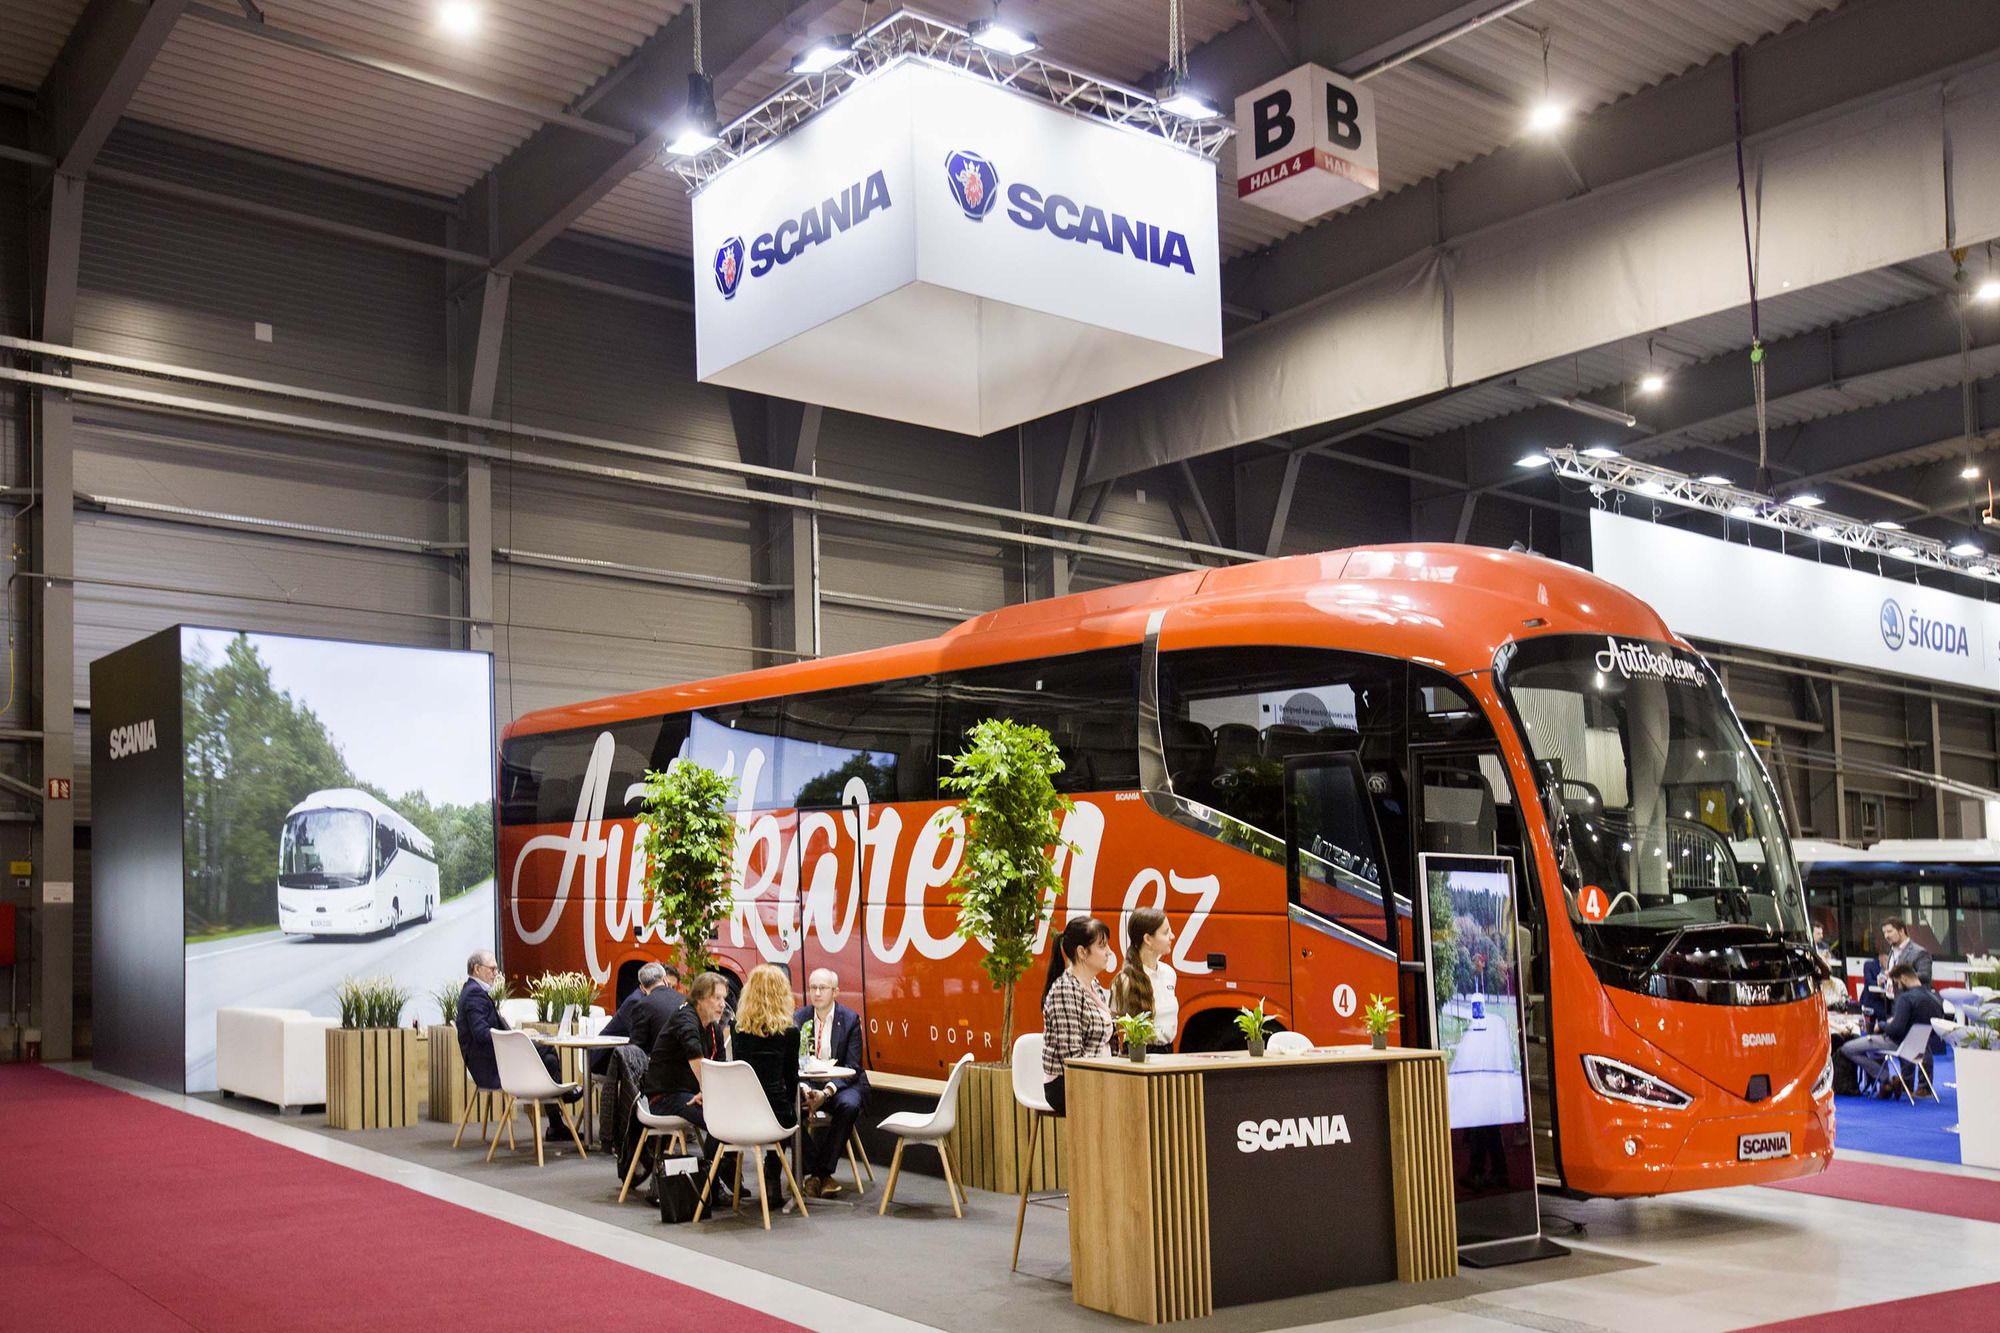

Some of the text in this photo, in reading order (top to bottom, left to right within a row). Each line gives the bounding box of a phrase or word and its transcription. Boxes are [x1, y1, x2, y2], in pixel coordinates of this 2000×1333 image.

[1253, 89, 1295, 160] B
[1327, 82, 1361, 151] B
[1250, 157, 1301, 191] HALA 4
[751, 170, 892, 278] SCANIA
[1007, 182, 1196, 276] SCANIA
[1908, 608, 1969, 657] ŠKODA
[110, 719, 157, 760] SCANIA
[1115, 792, 1140, 801] SCANIA
[1586, 889, 1600, 918] 4
[1339, 989, 1348, 1012] 4
[1742, 1033, 1776, 1047] SCANIA
[1237, 1114, 1351, 1153] SCANIA
[1743, 1137, 1787, 1155] SCANIA
